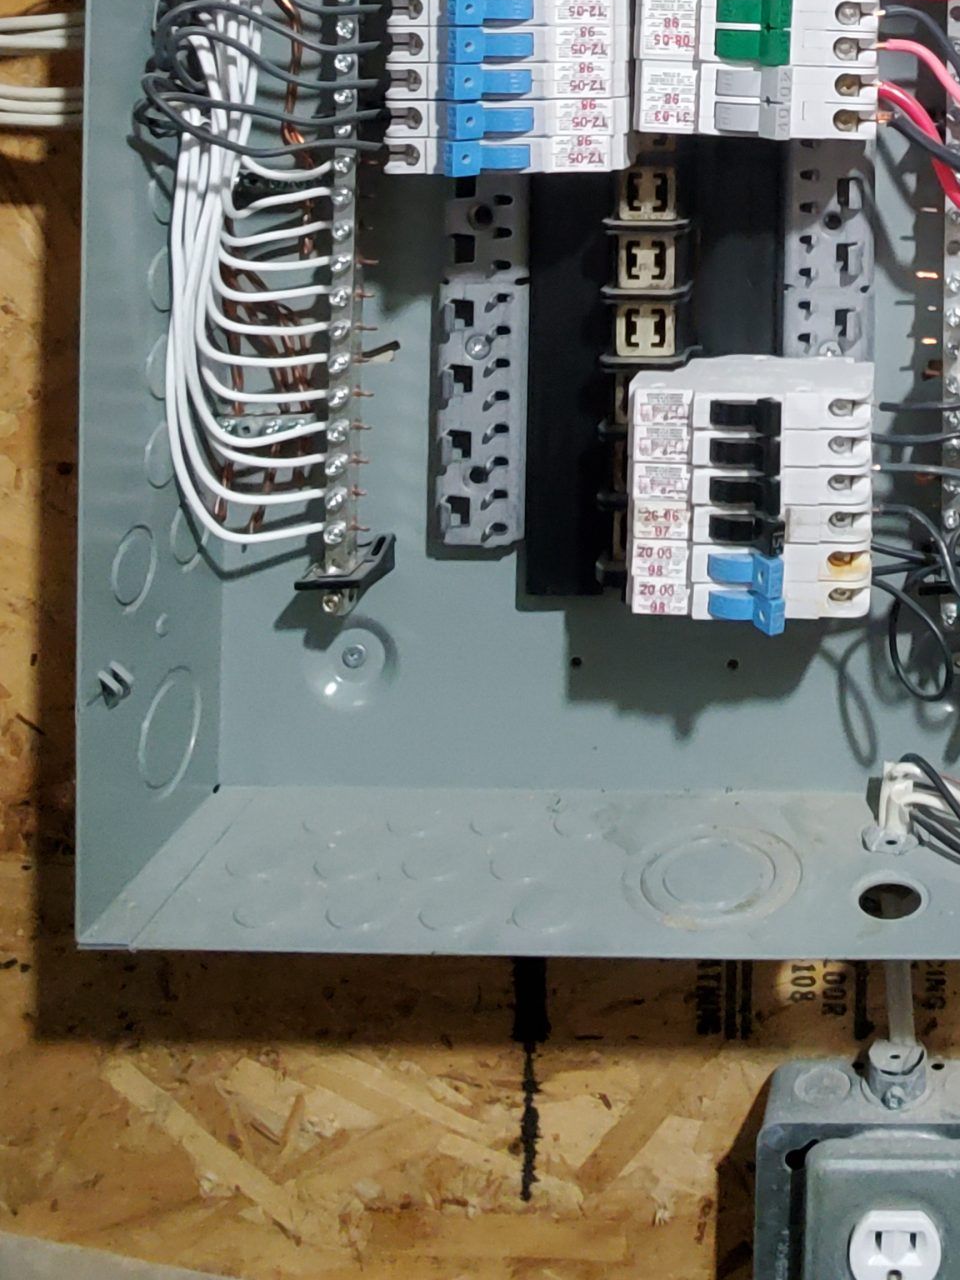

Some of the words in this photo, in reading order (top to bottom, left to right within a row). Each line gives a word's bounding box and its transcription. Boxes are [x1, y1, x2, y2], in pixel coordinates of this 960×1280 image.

[664, 17, 680, 28] 98
[664, 93, 679, 105] 98
[648, 565, 663, 576] 98
[650, 601, 665, 613] 98
